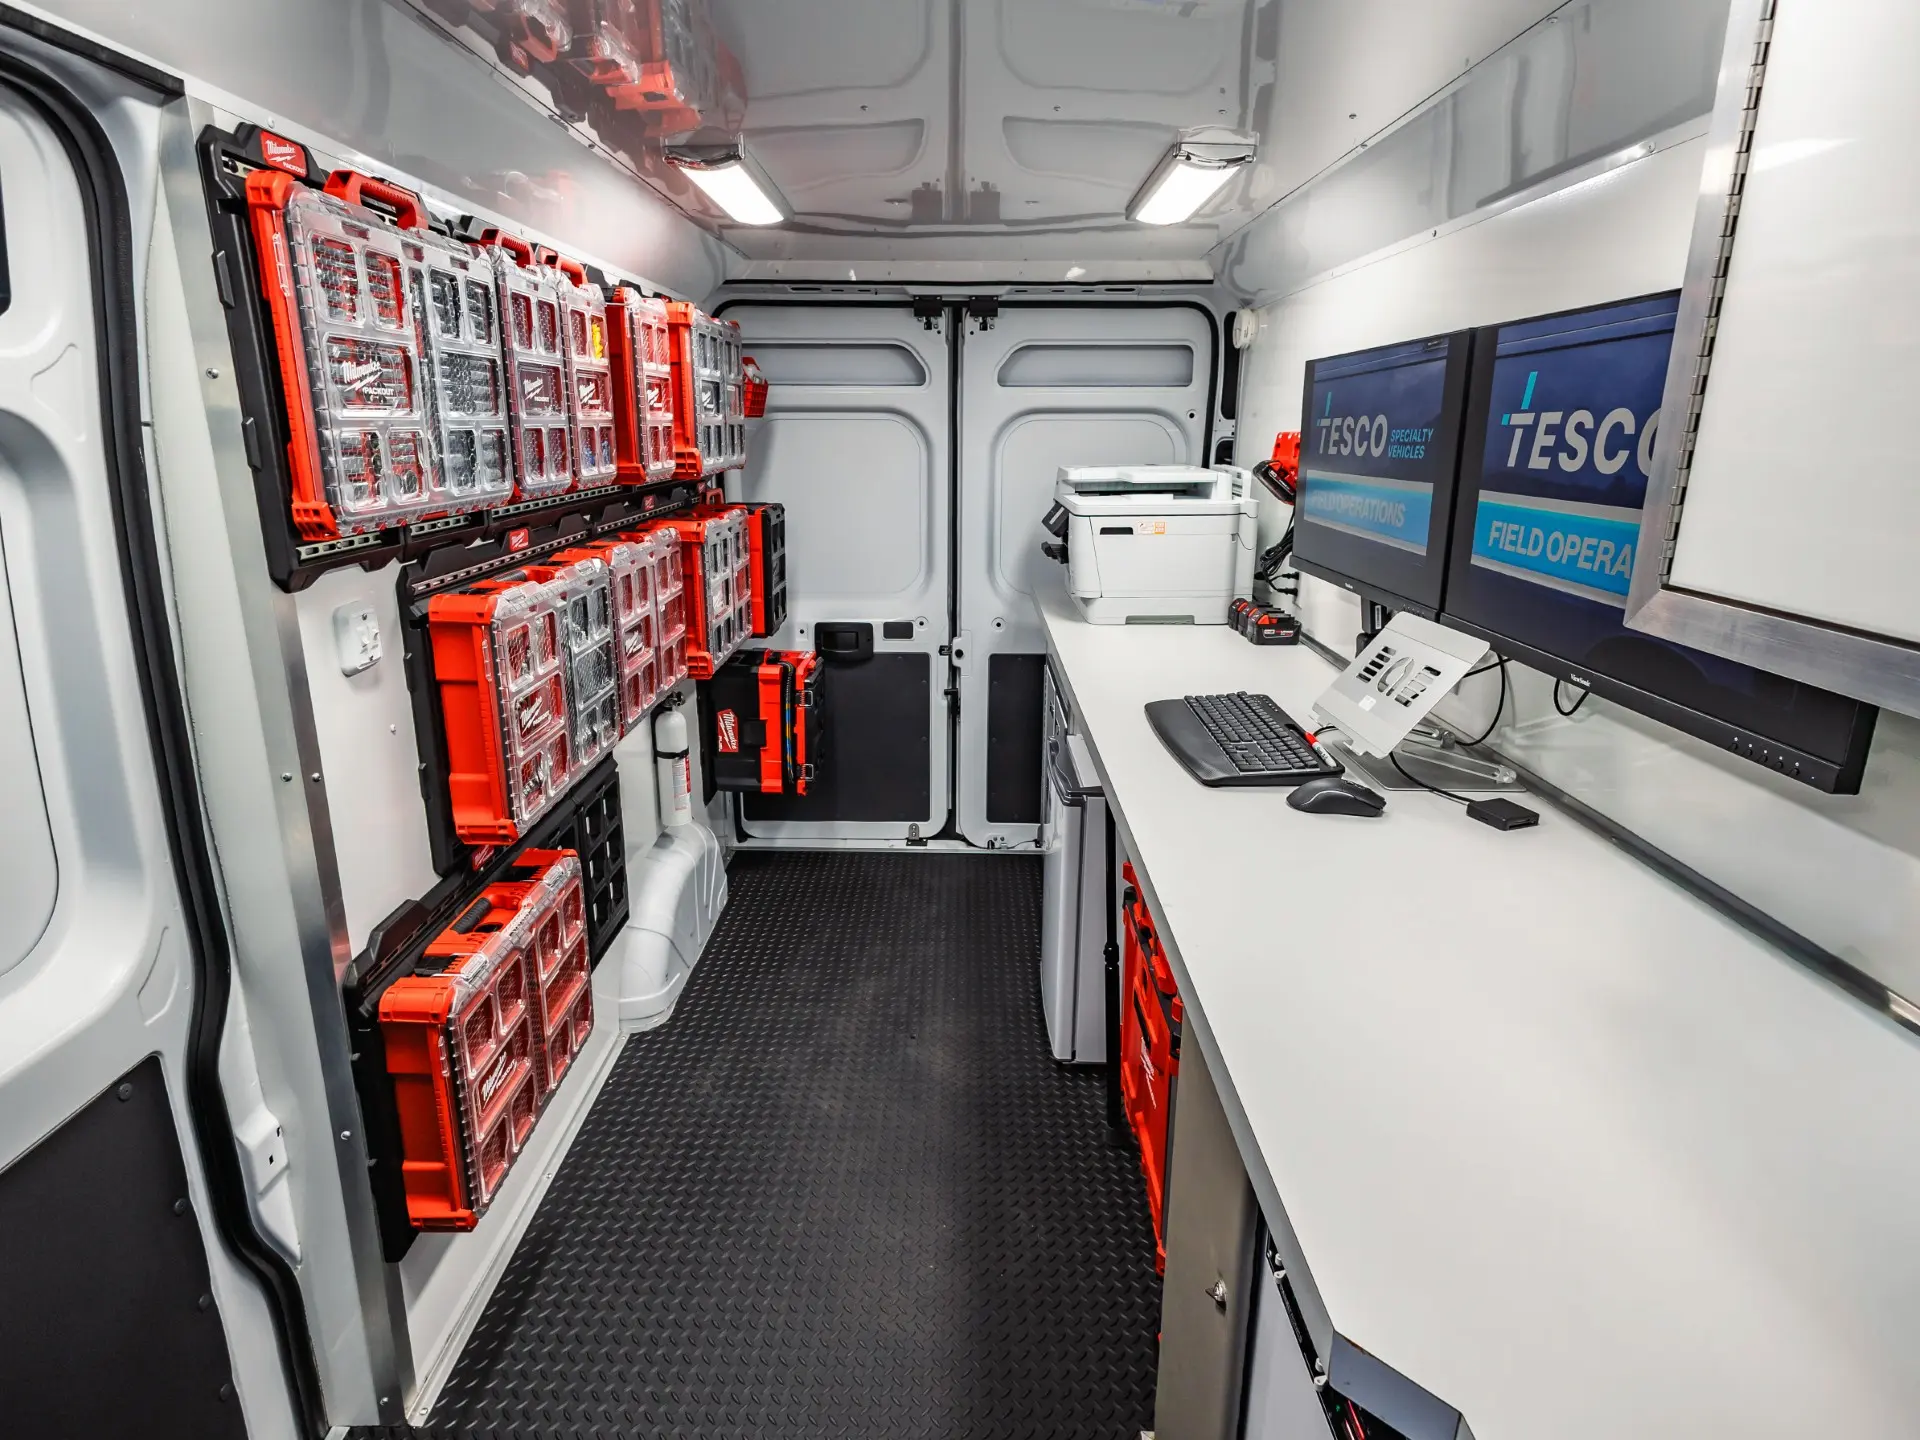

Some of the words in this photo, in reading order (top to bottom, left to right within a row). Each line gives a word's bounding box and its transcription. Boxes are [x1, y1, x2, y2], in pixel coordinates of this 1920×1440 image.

[265, 139, 296, 156] Milwaukee
[340, 359, 382, 384] Milwaukee
[362, 386, 395, 396] PACKOUT
[1317, 414, 1388, 458] TESCO
[1390, 427, 1434, 443] SPECIALTY
[1387, 444, 1425, 459] VEHICLES
[1336, 493, 1406, 528] OPERATIONS
[1488, 520, 1545, 557] FIELD
[722, 711, 737, 750] Milwaukee
